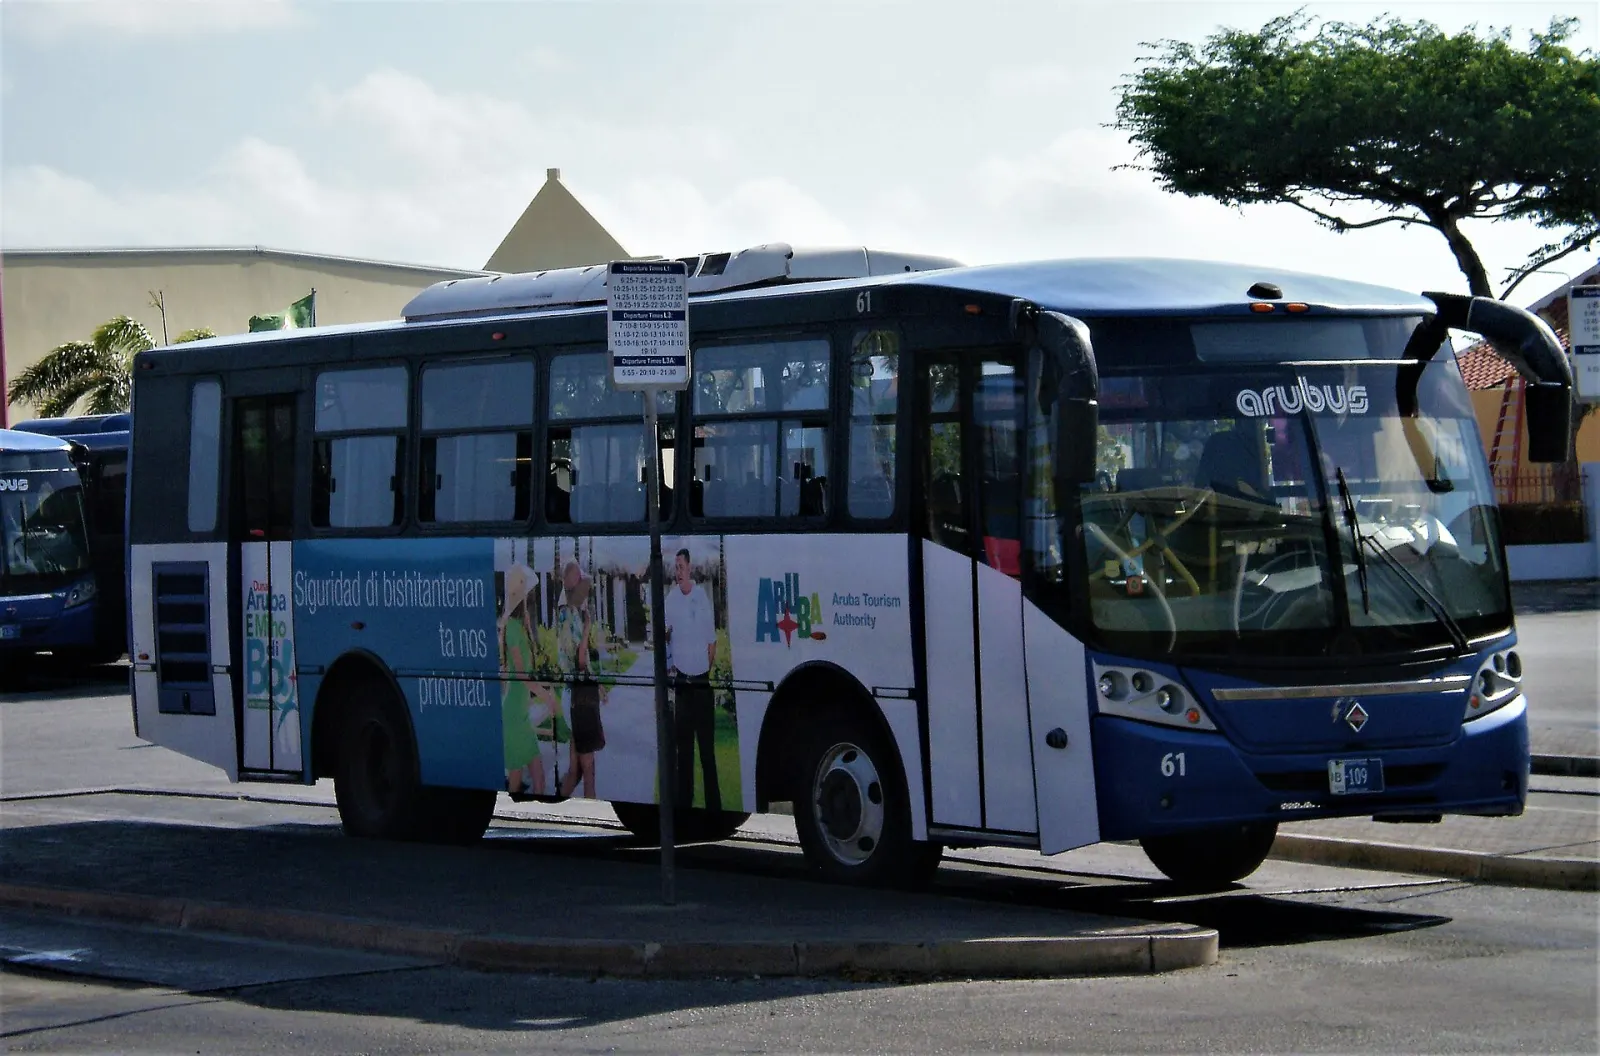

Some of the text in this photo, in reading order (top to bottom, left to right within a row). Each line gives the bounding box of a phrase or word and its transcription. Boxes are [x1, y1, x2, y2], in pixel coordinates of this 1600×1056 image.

[856, 291, 870, 313] 61
[1236, 375, 1369, 417] arubus
[294, 570, 485, 615] Siguridad di bishitantenan
[756, 572, 823, 643] ARUBA
[832, 592, 901, 608] Aruba Tourism
[246, 614, 254, 637] E
[833, 612, 877, 630] Authority
[438, 621, 488, 658] ta nos
[418, 671, 491, 713] prioridad.
[1161, 752, 1185, 777] 61
